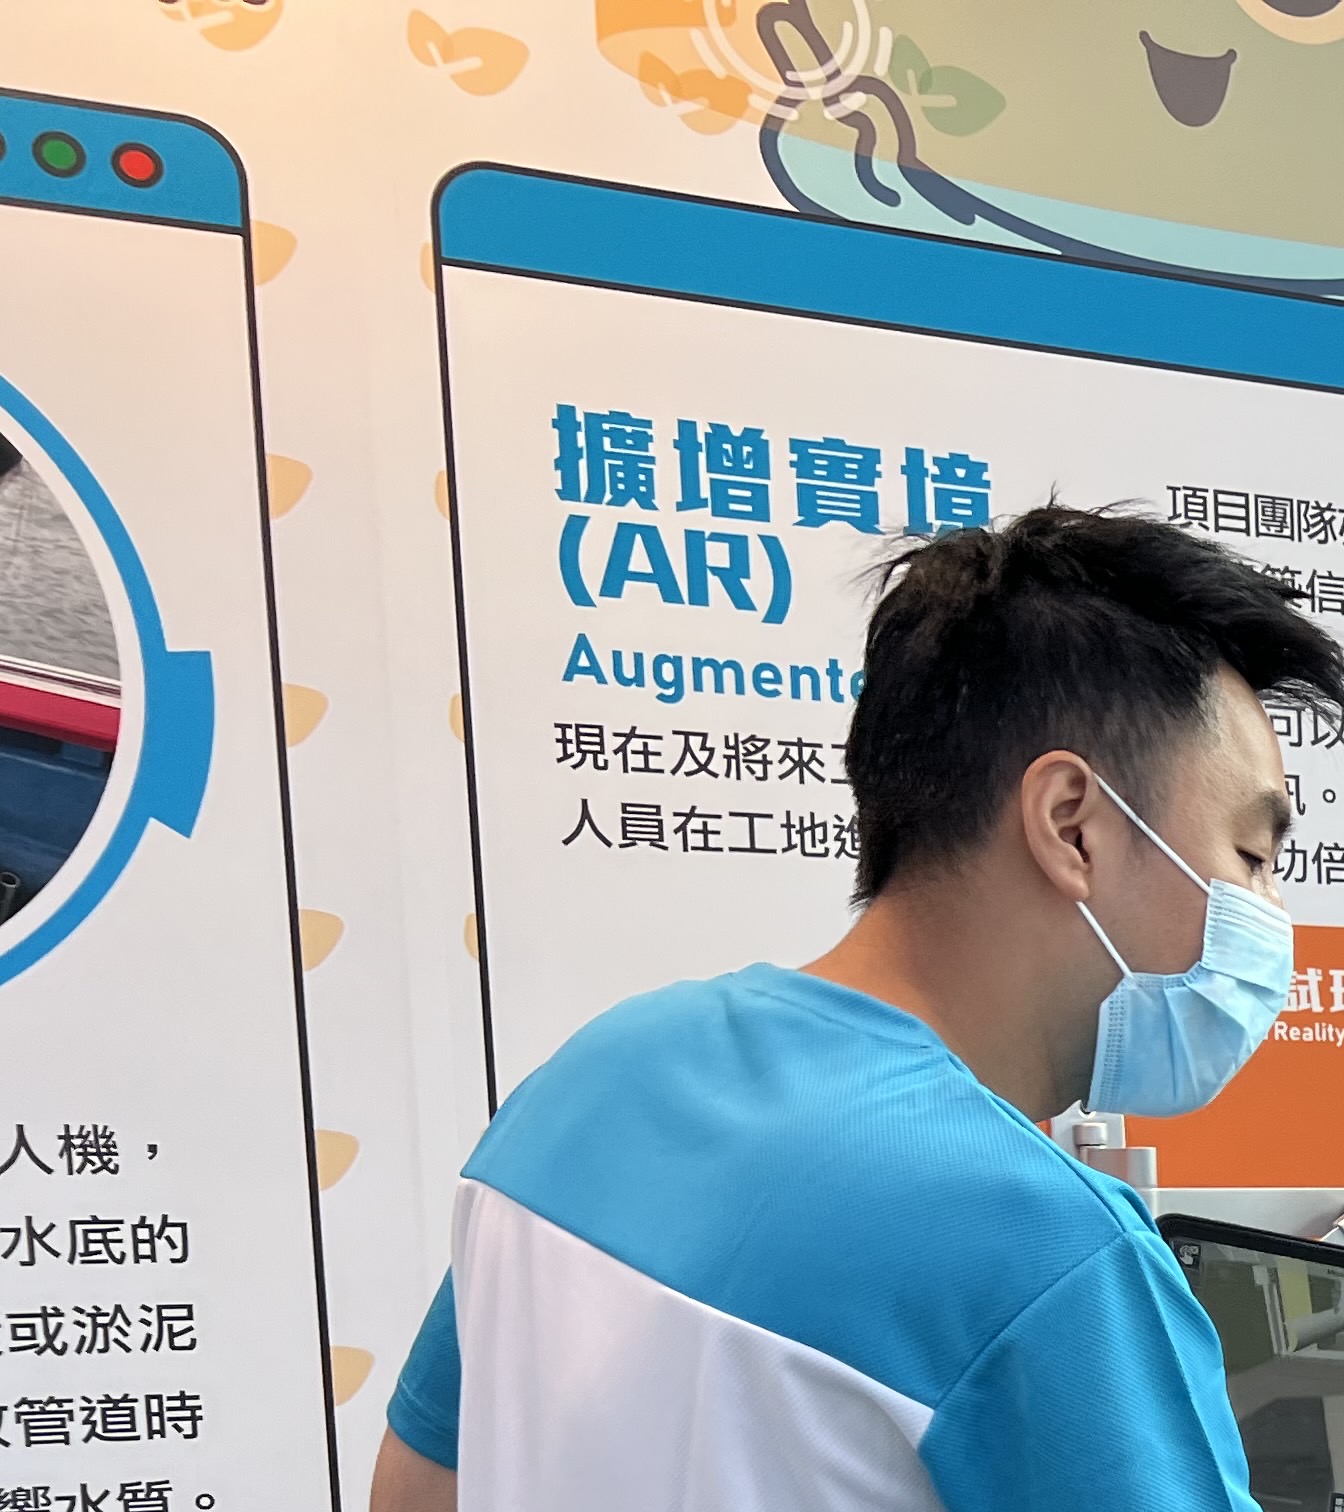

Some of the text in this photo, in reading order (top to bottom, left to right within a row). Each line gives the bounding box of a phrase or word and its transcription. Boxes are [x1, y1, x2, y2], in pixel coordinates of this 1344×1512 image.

[551, 402, 992, 536] 擴增實境
[559, 514, 792, 625] (AR)
[0, 1303, 197, 1358] 或淤泥
[0, 1389, 204, 1449] 管道時
